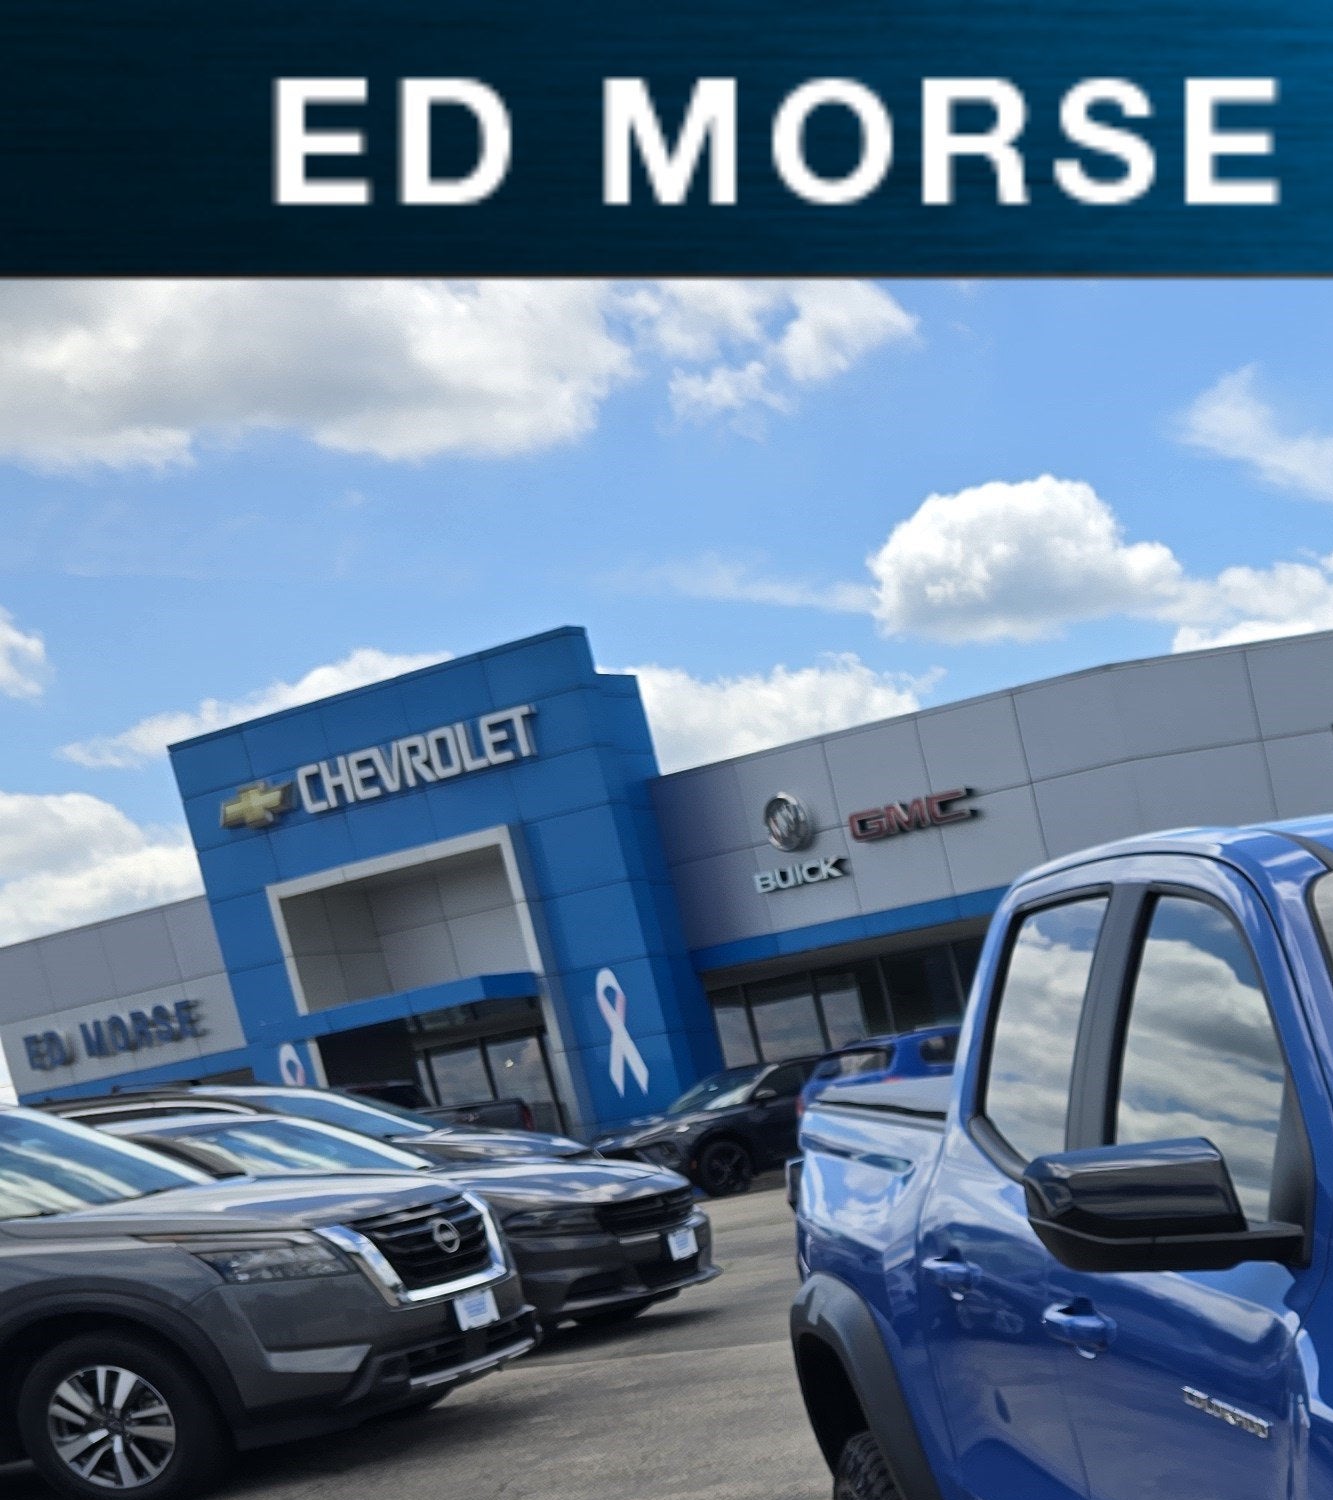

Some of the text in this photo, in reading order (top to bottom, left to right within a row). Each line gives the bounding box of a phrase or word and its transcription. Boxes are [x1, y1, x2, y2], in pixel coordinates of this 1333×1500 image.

[297, 703, 536, 814] CHEVROLET
[848, 786, 974, 843] GMC
[754, 855, 845, 893] BUICK
[22, 999, 206, 1071] ED MORSE
